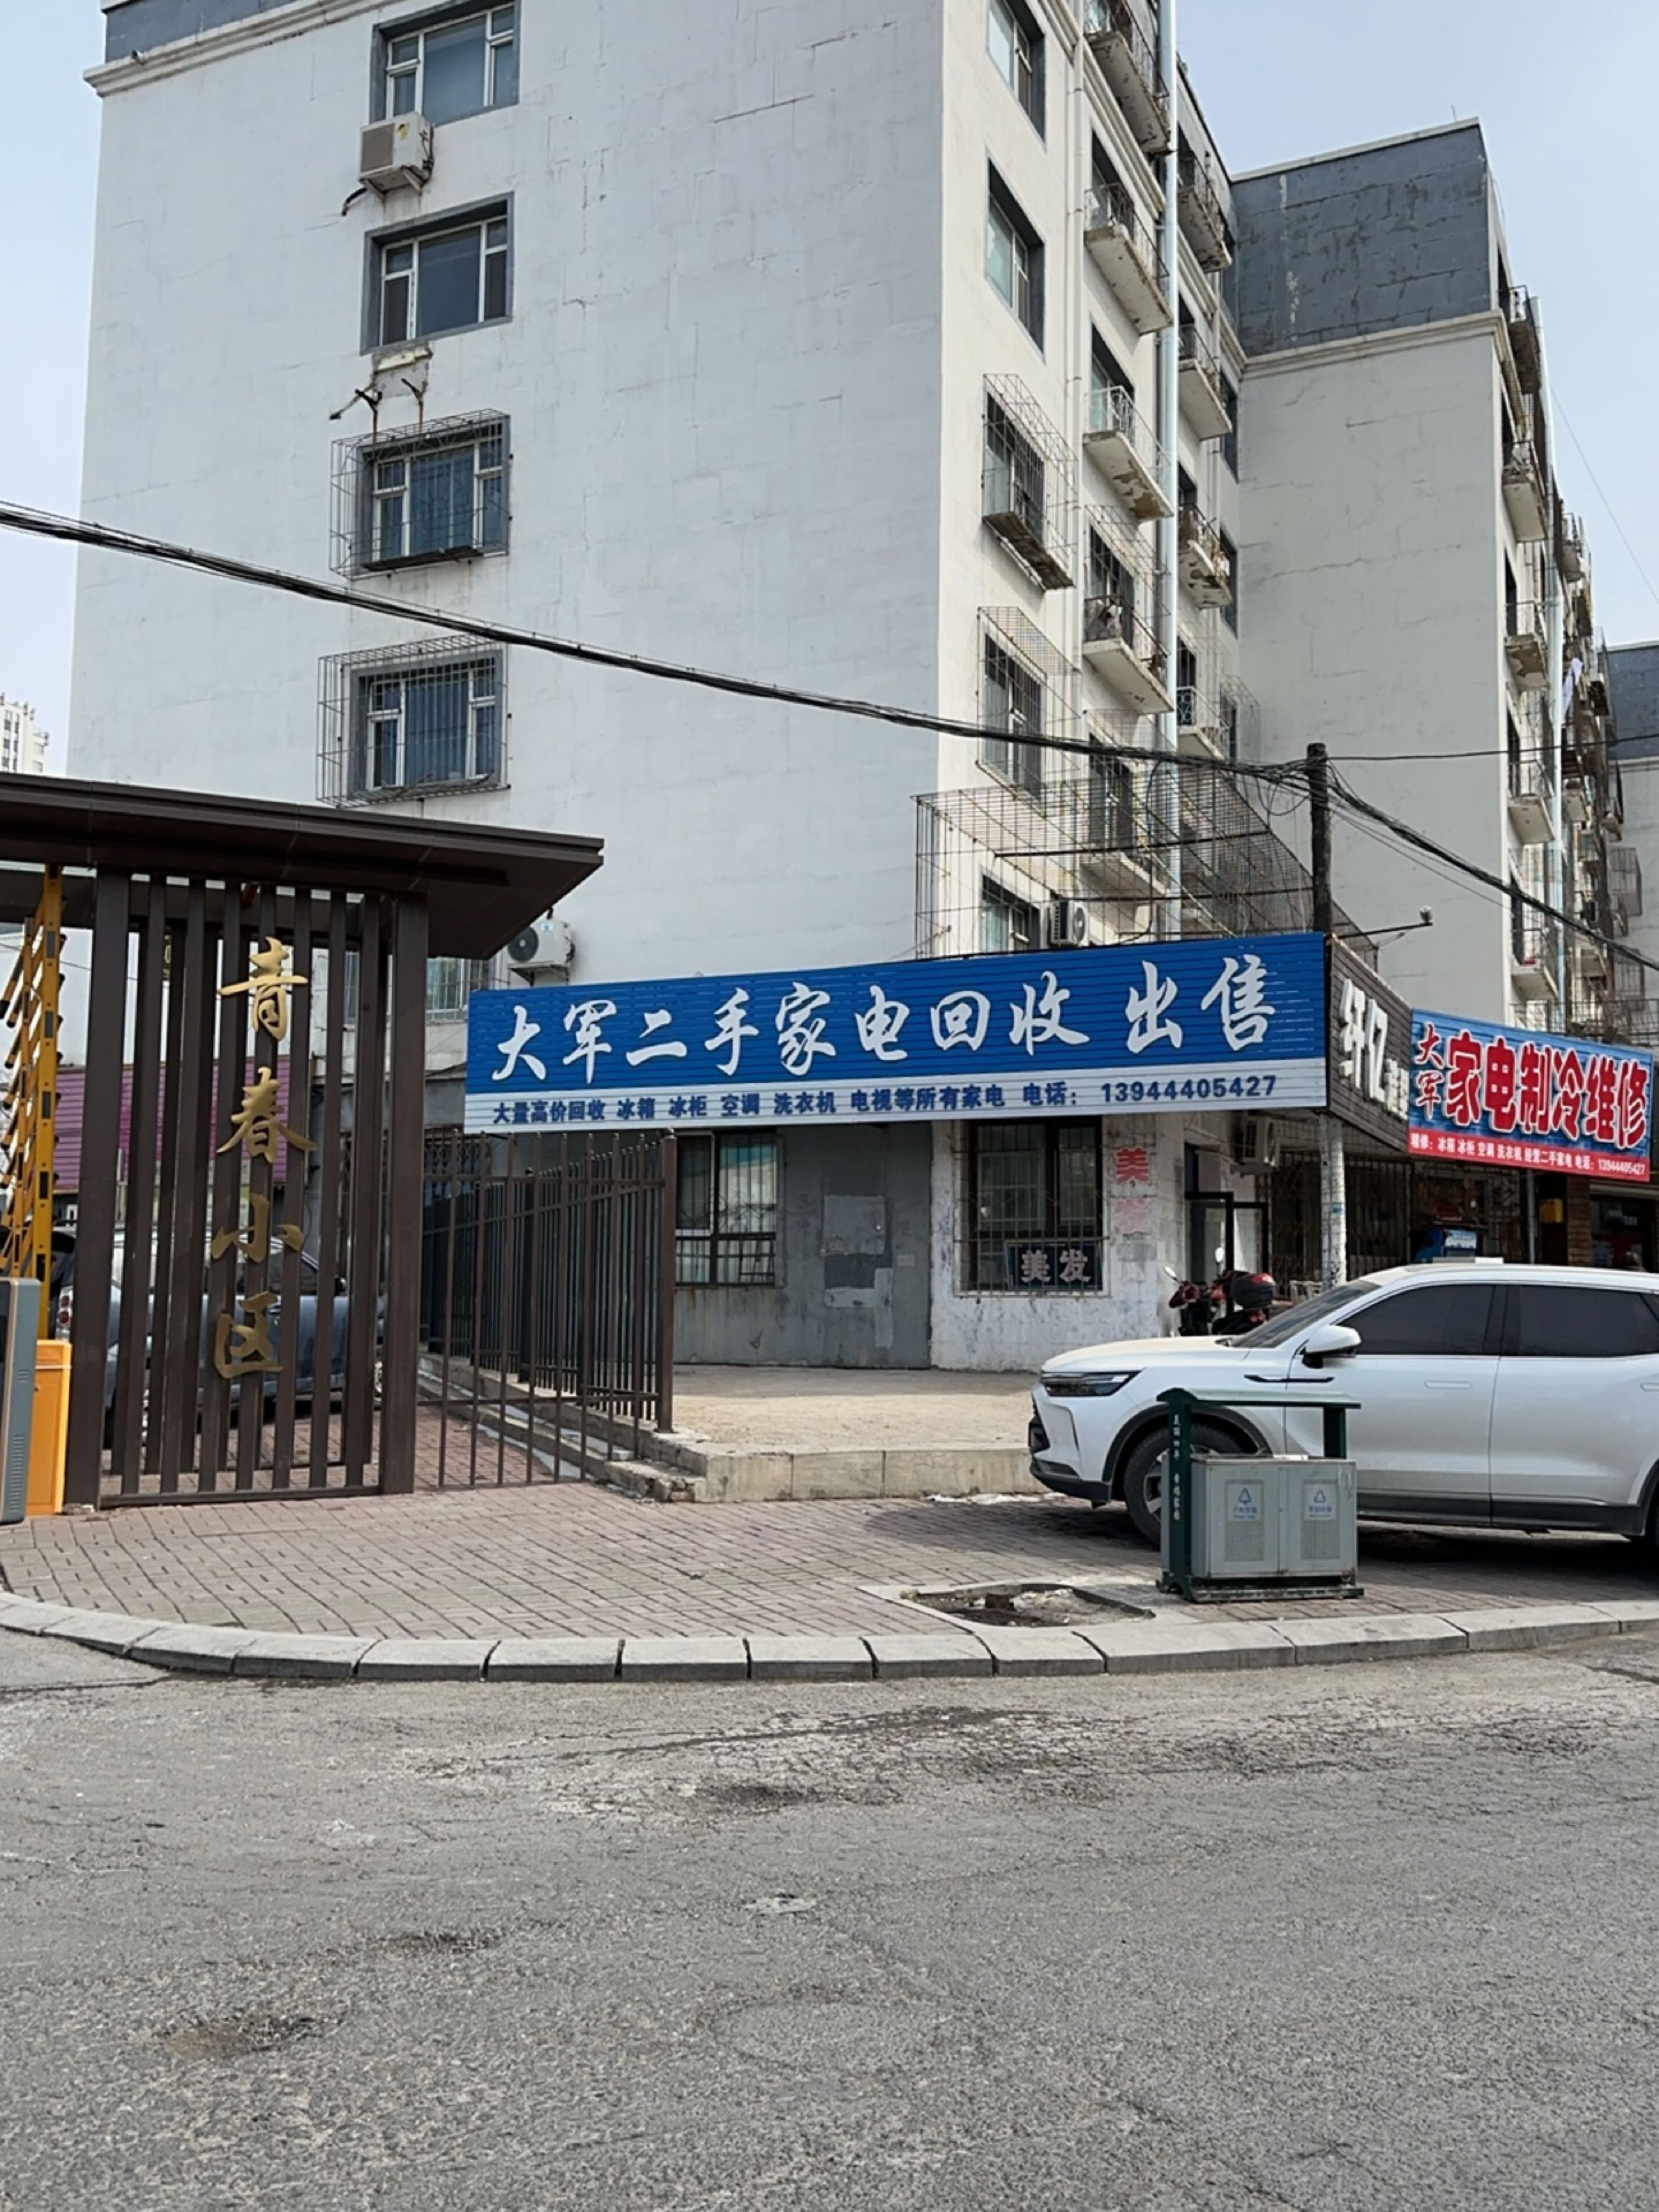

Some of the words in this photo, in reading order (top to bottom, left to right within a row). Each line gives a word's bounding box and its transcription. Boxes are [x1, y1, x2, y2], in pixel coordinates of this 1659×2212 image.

[493, 1099, 606, 1124] 大量高价回收
[617, 1098, 655, 1119] 冰箱
[669, 1096, 707, 1118] 冰柜
[721, 1093, 760, 1116] 空调
[773, 1091, 836, 1114] 洗衣机
[851, 1085, 1006, 1112] 电视等所有家电
[1102, 1075, 1276, 1102] 13944405427
[1415, 1023, 1444, 1120] 大军
[1446, 1030, 1649, 1150] 家电制冷维修
[211, 936, 318, 1379] 青春小区
[1021, 1249, 1091, 1283] 美发
